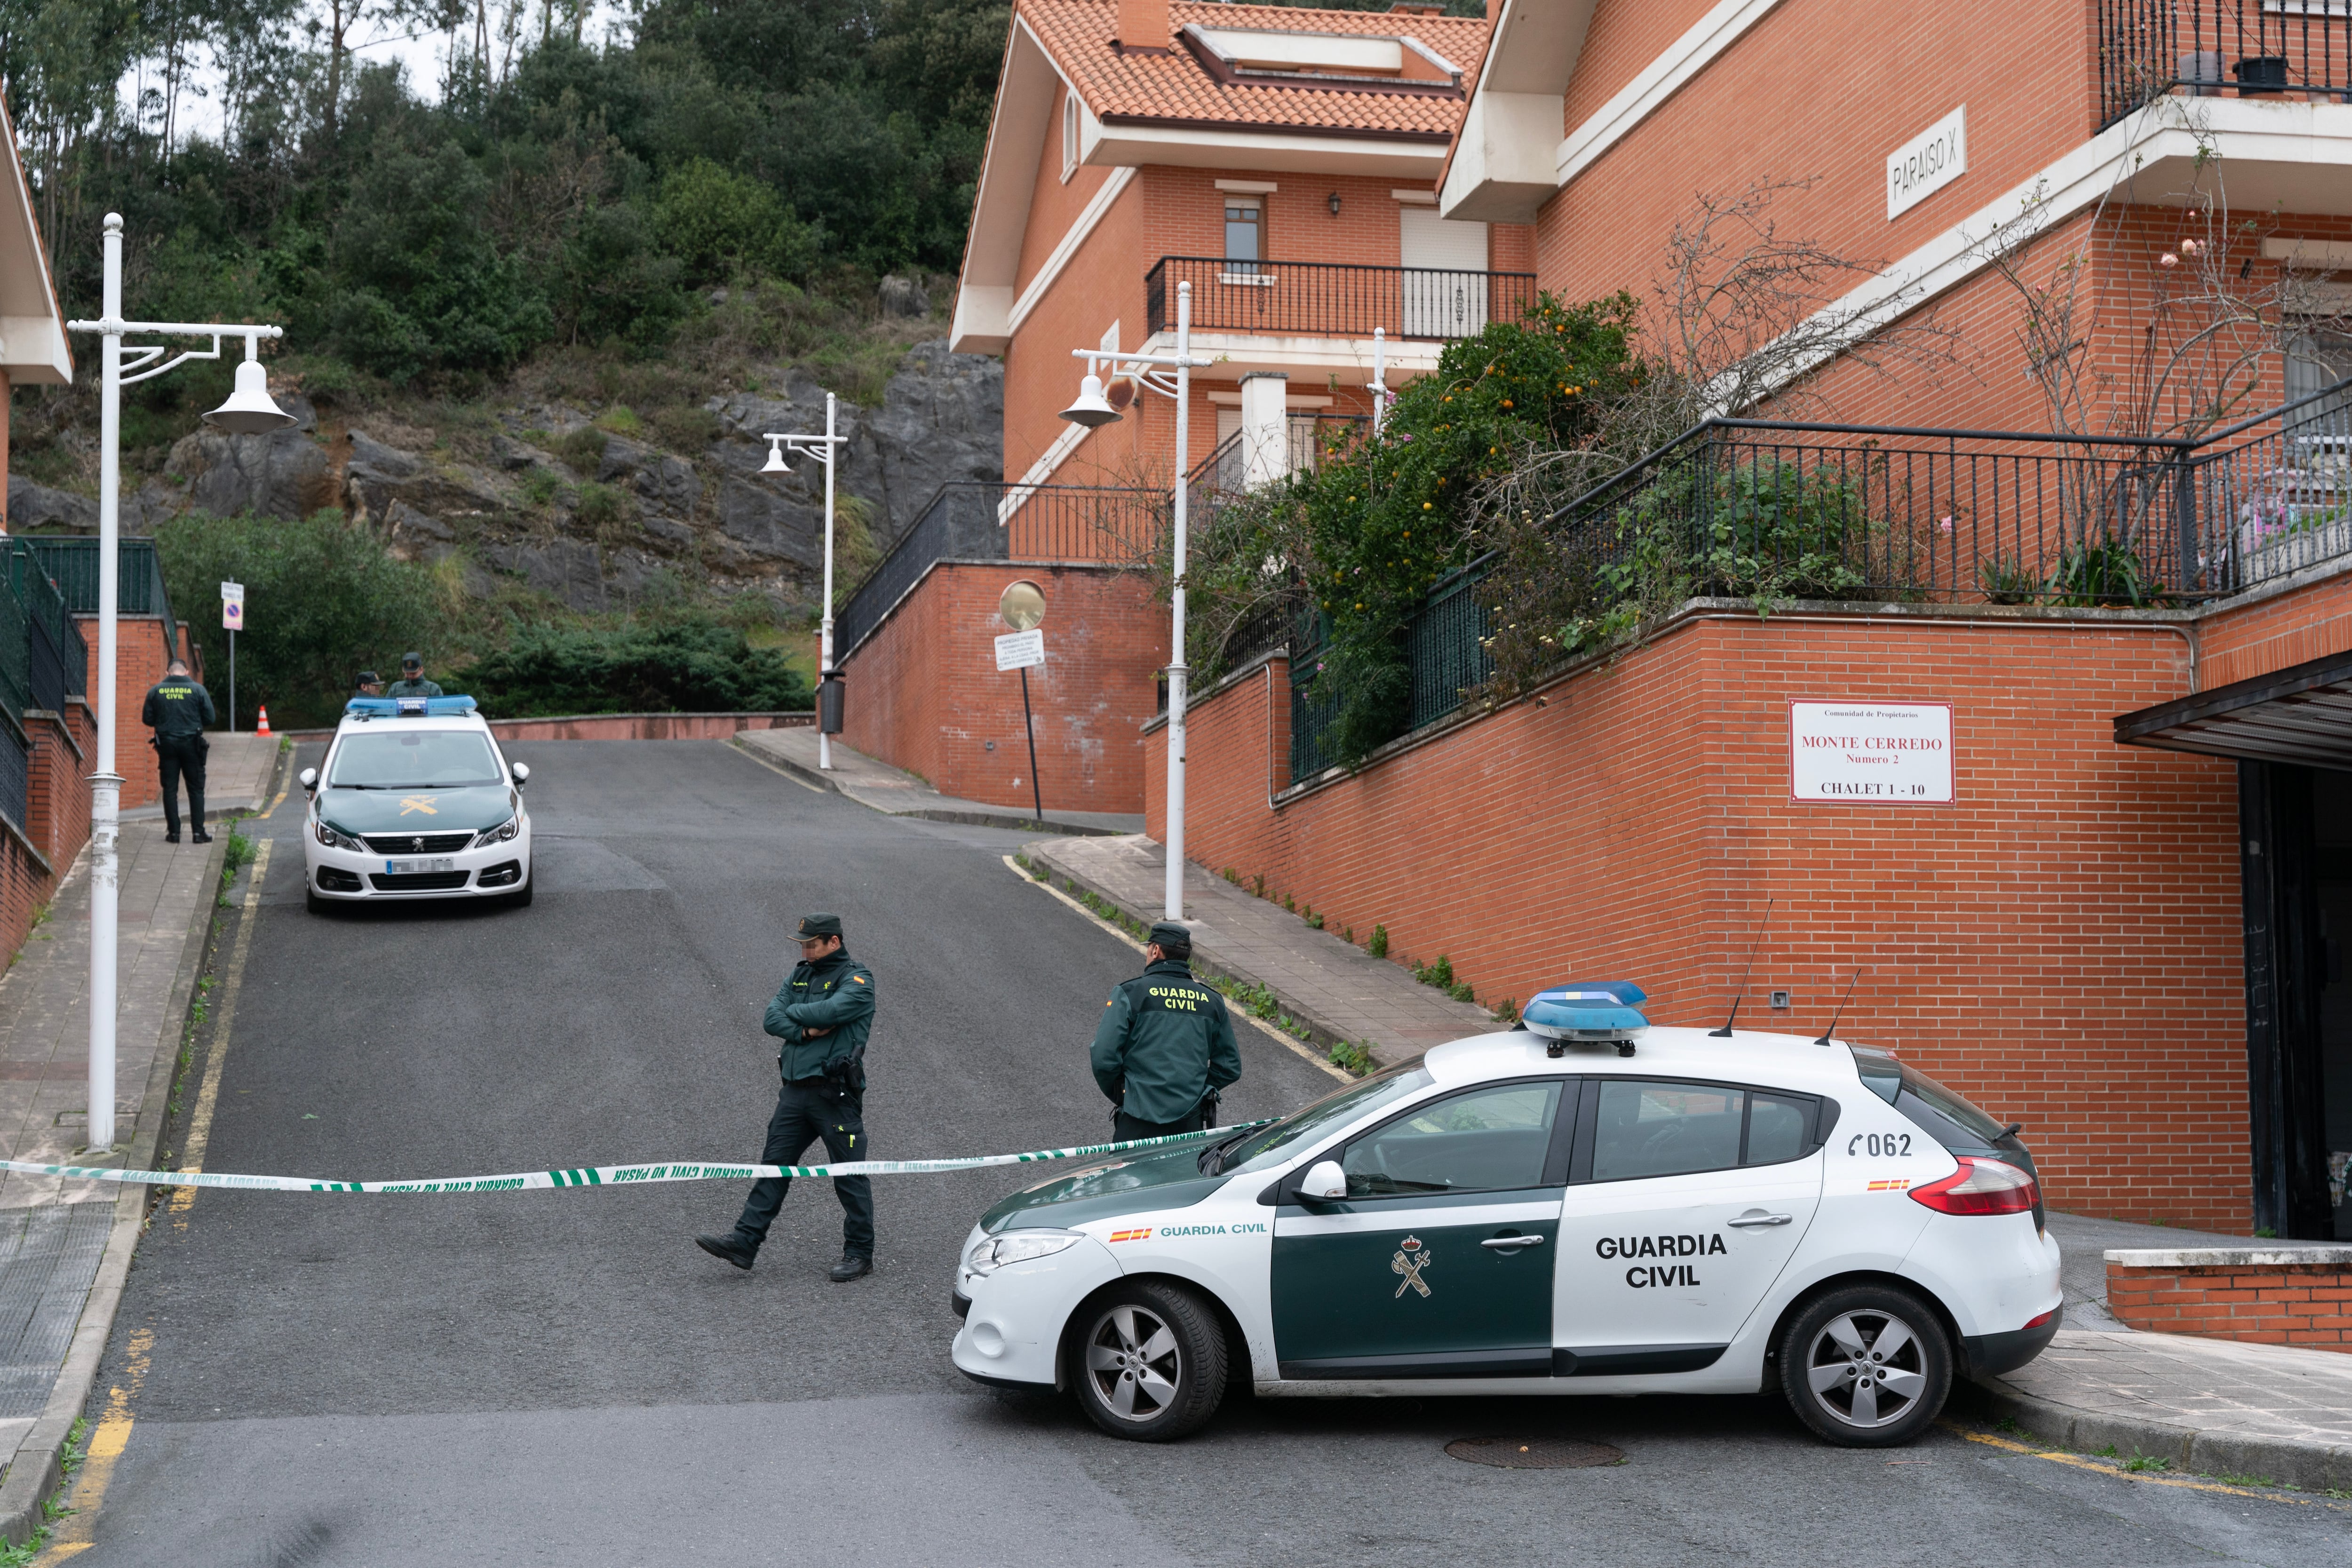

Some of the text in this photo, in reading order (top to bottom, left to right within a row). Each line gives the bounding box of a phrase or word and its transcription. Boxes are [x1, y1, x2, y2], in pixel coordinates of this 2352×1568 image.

[1894, 127, 1956, 200] PARAISO X
[1802, 736, 1942, 750] MONTE CERREDO
[1847, 754, 1899, 764] Número 2
[1821, 782, 1883, 794] CHALET
[1889, 784, 1894, 795] 1
[1911, 784, 1925, 795] 10
[1149, 987, 1209, 1002] GUARDIA
[1165, 998, 1196, 1011] CIVIL
[1867, 1133, 1912, 1156] 062
[612, 1168, 650, 1182] PASAR
[651, 1166, 668, 1178] NO
[670, 1166, 699, 1178] CIVIL
[474, 1178, 524, 1192] GUARDIA
[1161, 1223, 1267, 1237] GUARDIA CIVIL
[1596, 1234, 1727, 1259] GUARDIA
[1626, 1265, 1700, 1288] CIVIL
